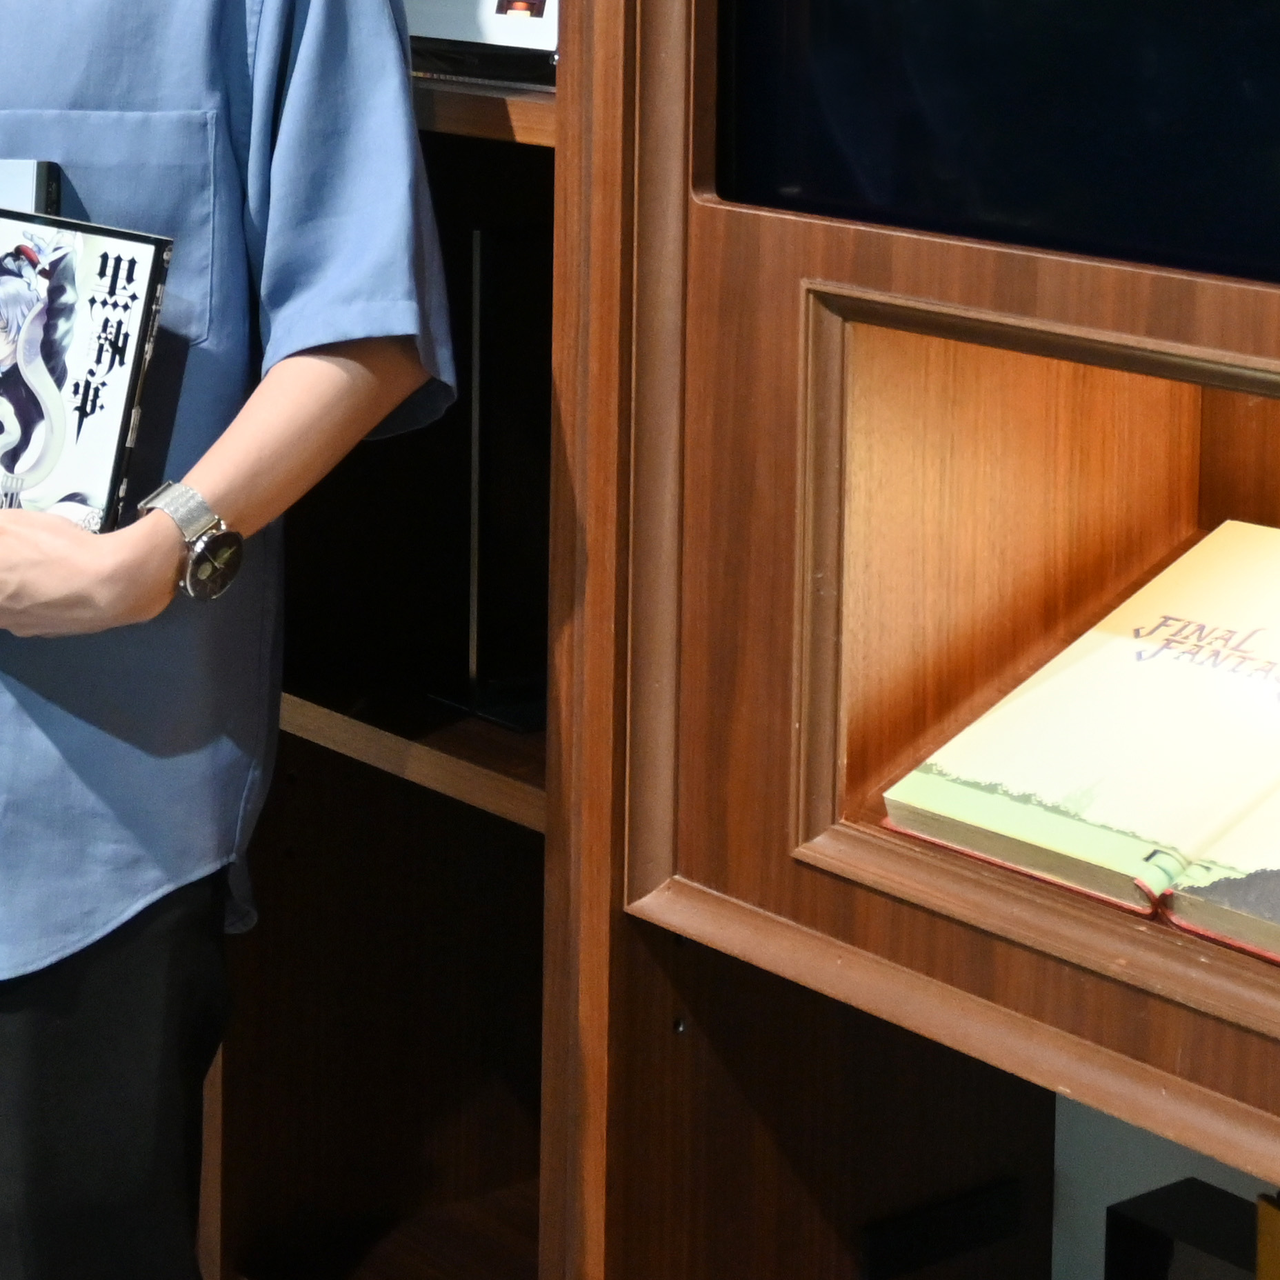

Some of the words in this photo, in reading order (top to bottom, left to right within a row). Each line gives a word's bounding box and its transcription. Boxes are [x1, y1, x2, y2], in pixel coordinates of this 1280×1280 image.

[68, 251, 140, 445] 黒執事
[1133, 615, 1268, 654] FINAL
